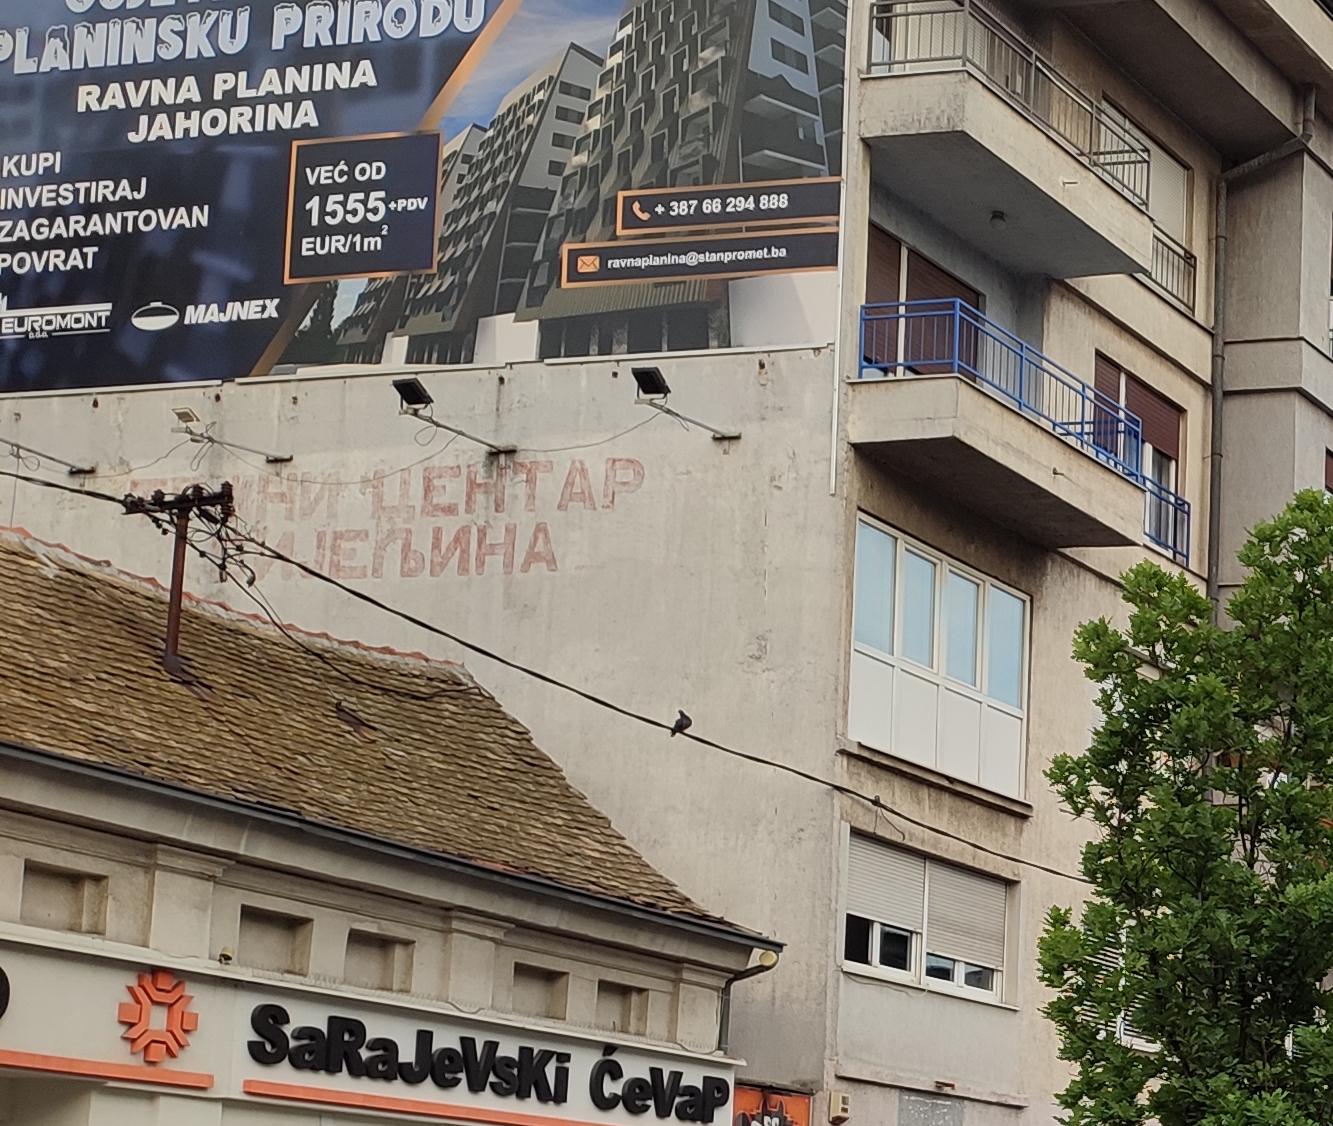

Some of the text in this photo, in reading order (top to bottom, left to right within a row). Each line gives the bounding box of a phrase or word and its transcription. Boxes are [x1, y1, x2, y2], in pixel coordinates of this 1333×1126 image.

[0, 0, 485, 75] PLANINSKU PRIRODU
[77, 59, 378, 113] RAVNA PLANINA
[127, 100, 319, 143] JAHORINA
[2, 151, 62, 178] KUPI
[305, 161, 387, 186] VEĆ OD
[0, 177, 147, 210] INVESTIRAJ
[305, 191, 428, 227] 1555 +PDV
[669, 200, 698, 217] 387
[702, 199, 721, 215] 66
[726, 196, 755, 212] 294
[760, 193, 789, 210] 888
[0, 205, 209, 243] ZAGARANTOVAN
[0, 247, 98, 276] POVRAT
[607, 247, 787, 270] ravnaplanina@stanpromet.ba
[1, 310, 111, 334] EUROMONT
[184, 299, 280, 325] MAJNEX
[371, 457, 645, 521] ЦЕНТАР
[212, 519, 558, 583] ИЈЕЉИНА
